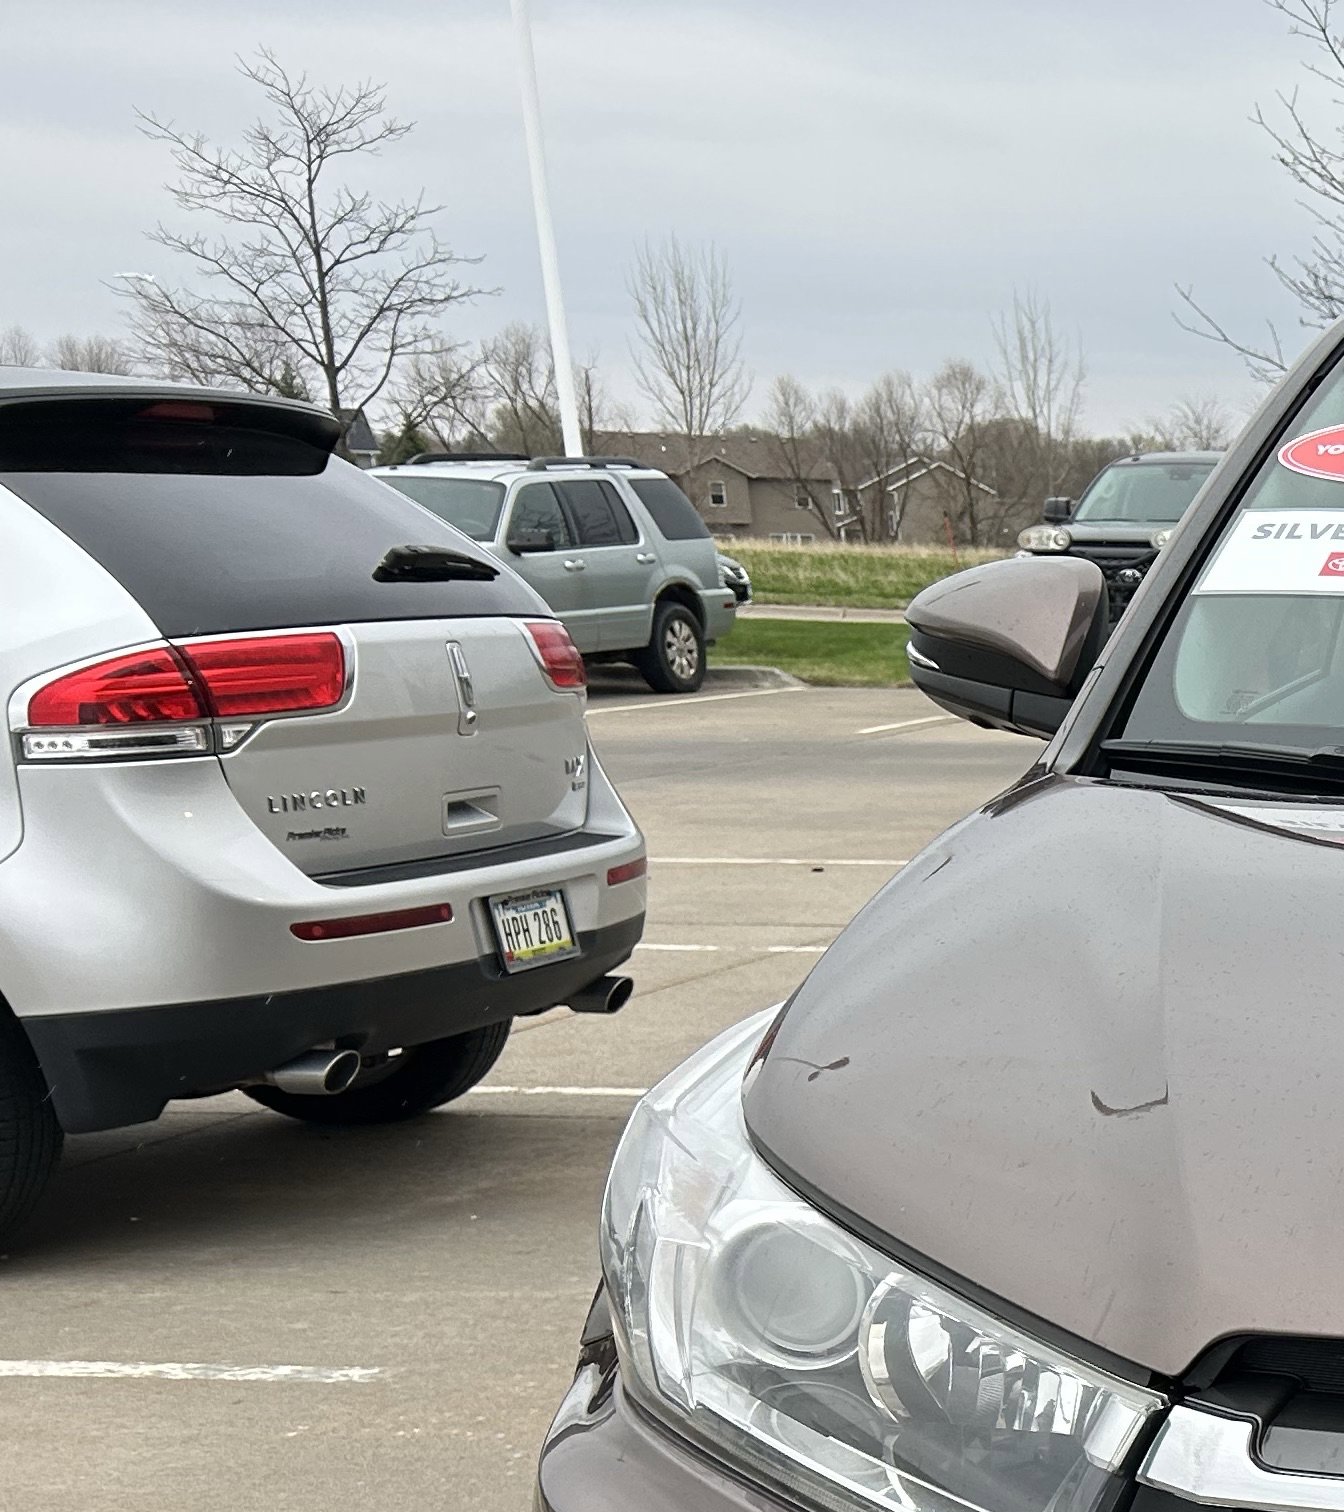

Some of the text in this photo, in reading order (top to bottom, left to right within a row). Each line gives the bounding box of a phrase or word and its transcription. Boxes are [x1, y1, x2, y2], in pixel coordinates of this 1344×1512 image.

[267, 786, 366, 814] LINCOLN
[502, 907, 562, 951] HPH 286
